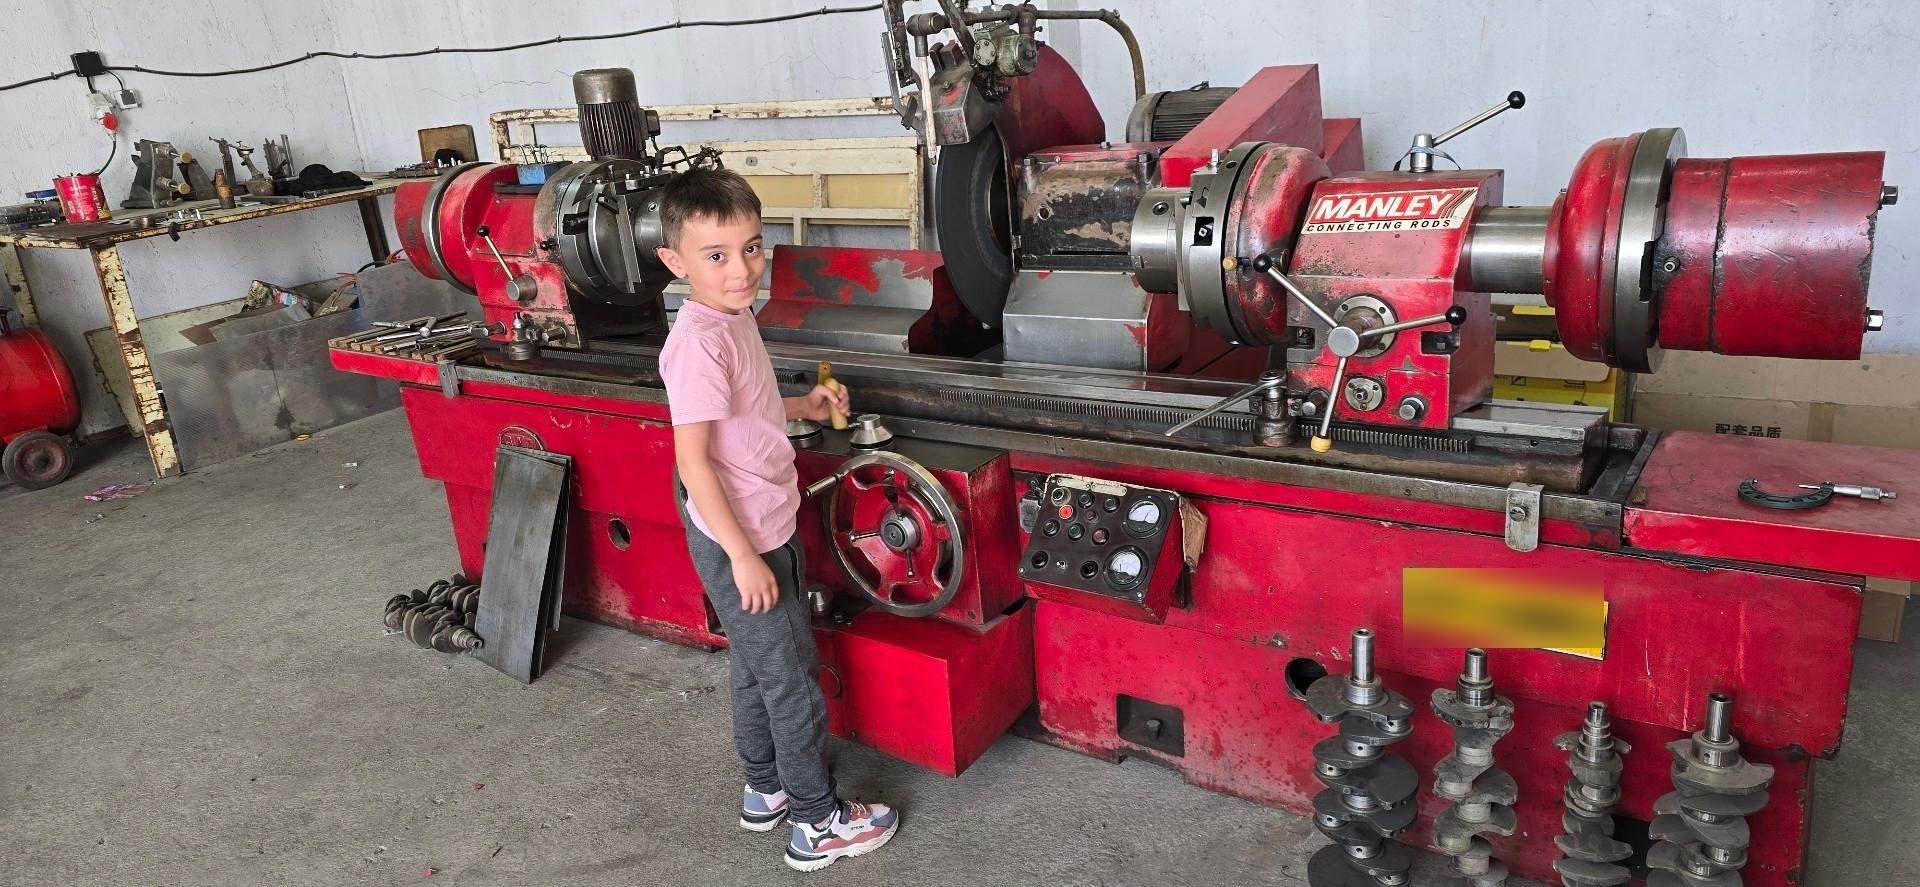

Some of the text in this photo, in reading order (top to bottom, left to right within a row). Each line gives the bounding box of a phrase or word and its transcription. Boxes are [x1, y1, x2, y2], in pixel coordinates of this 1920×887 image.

[1314, 193, 1454, 220] MANLEY
[1307, 219, 1451, 232] CONNECTING RODS
